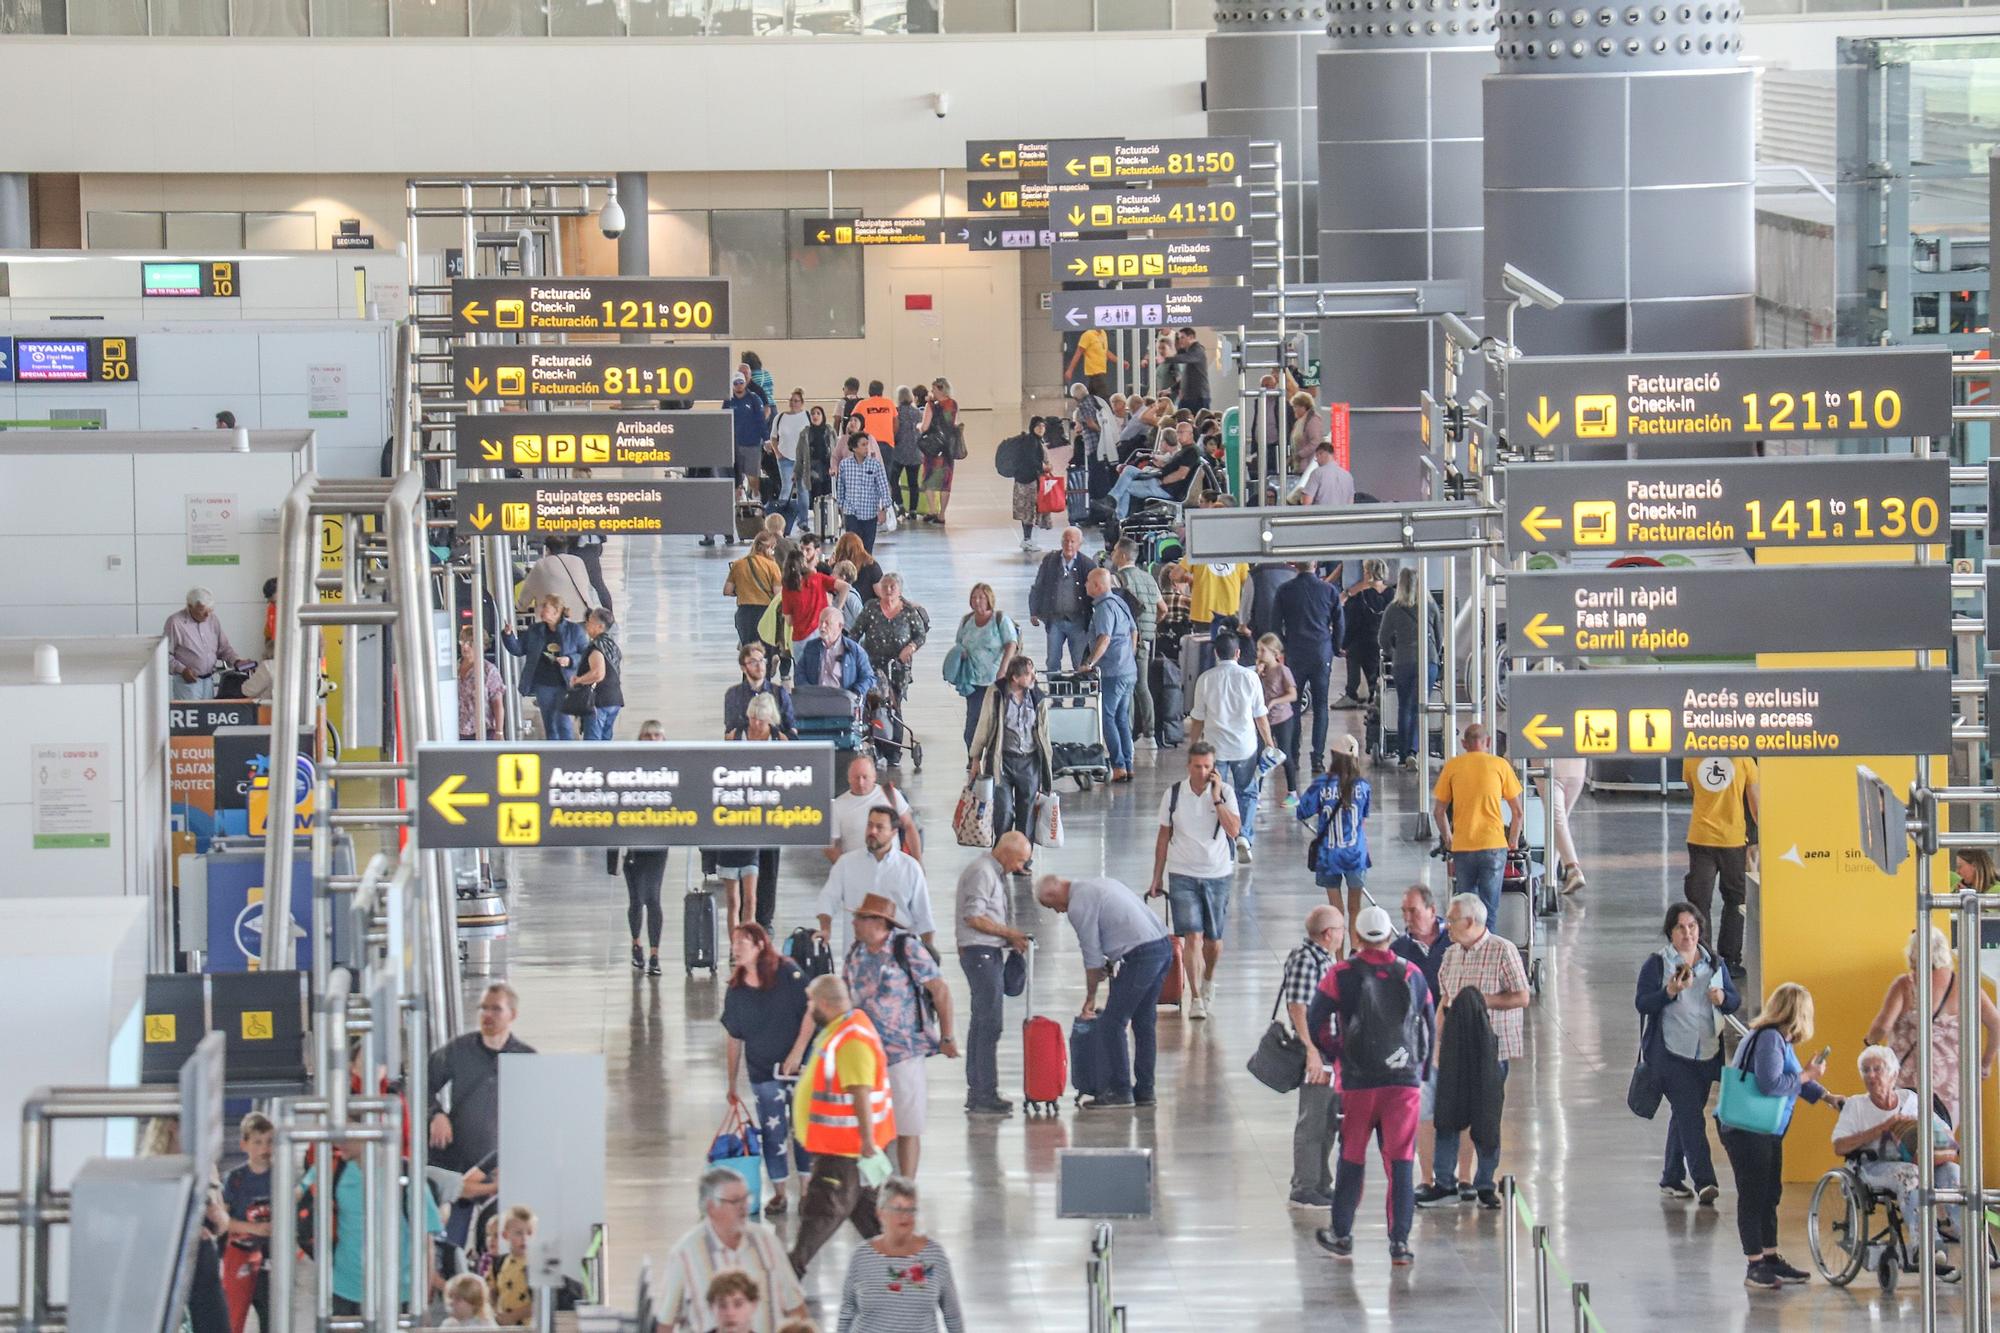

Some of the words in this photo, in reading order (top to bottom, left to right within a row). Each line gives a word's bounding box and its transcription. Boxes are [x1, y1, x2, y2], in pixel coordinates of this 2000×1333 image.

[1115, 145, 1159, 155] Facturació
[1116, 156, 1148, 164] Check-in
[1116, 166, 1165, 175] Facturación
[1168, 153, 1195, 173] 81
[1206, 152, 1234, 172] 50
[1117, 194, 1160, 204] Facturació
[1117, 205, 1149, 214] Check-in
[1117, 215, 1166, 224] Facturación
[1168, 203, 1196, 222] 41
[1208, 202, 1235, 221] 10
[855, 220, 893, 229] Equipatges
[894, 219, 925, 229] especials
[855, 234, 891, 243] Equipajes
[891, 234, 925, 243] especiales
[1168, 243, 1210, 255] Arribades
[1168, 254, 1196, 263] Arrivals
[1168, 262, 1208, 275] Llegadas
[213, 281, 233, 295] 10
[531, 288, 591, 300] Facturació
[1166, 294, 1202, 303] Lavabos
[531, 301, 575, 312] Check-in
[659, 304, 669, 314] to
[1166, 305, 1191, 313] Toilets
[531, 315, 598, 327] Facturación
[602, 301, 656, 327] 121
[673, 302, 712, 328] 90
[1167, 315, 1192, 323] Aseos
[660, 318, 668, 327] a
[28, 344, 85, 353] RYANAIR
[532, 354, 592, 366] Facturació
[102, 361, 129, 380] 50
[532, 369, 576, 379] Check-in
[643, 370, 653, 380] to
[532, 382, 599, 393] Facturación
[604, 367, 640, 393] 81
[657, 368, 693, 394] 10
[1628, 373, 1720, 393] Facturació
[644, 385, 652, 393] a
[1628, 395, 1695, 413] Check-in
[1825, 391, 1840, 407] to
[1628, 412, 1731, 434] Facturación
[1743, 392, 1821, 432] 121
[1848, 390, 1901, 429] 10
[616, 422, 674, 434] Arribades
[1828, 415, 1837, 428] a
[616, 436, 655, 447] Arrivals
[617, 449, 670, 463] Llegadas
[1628, 479, 1722, 499] Facturació
[537, 490, 603, 505] Equipatges
[606, 490, 661, 503] especials
[537, 503, 573, 517] Special
[576, 503, 619, 515] check-in
[1628, 502, 1696, 520] Check-in
[1830, 498, 1846, 515] to
[537, 516, 596, 531] Equipajes
[599, 517, 661, 531] especiales
[1628, 519, 1733, 541] Facturación
[1746, 499, 1826, 540] 141
[1854, 497, 1938, 537] 130
[1833, 523, 1843, 537] a
[1575, 588, 1624, 607] Carril
[1631, 587, 1677, 610] ràpid
[1577, 610, 1609, 628] Fast
[1614, 610, 1646, 627] lane
[1576, 630, 1624, 649] Carril
[1632, 629, 1689, 651] rápido
[1684, 688, 1738, 708] Accés
[1745, 688, 1818, 707] exclusiu
[207, 712, 239, 725] BAG
[1683, 710, 1755, 728] Exclusive
[1760, 713, 1813, 727] access
[1685, 731, 1749, 750] Acceso
[1756, 731, 1838, 749] exclusivo
[550, 767, 602, 787] Accés
[607, 767, 679, 787] exclusiu
[713, 767, 762, 786] Carril
[766, 766, 812, 789] ràpid
[549, 789, 617, 806] Exclusive
[621, 791, 672, 805] access
[713, 785, 744, 804] Fast
[747, 788, 780, 804] lane
[550, 808, 613, 826] Acceso
[617, 807, 697, 826] exclusivo
[713, 807, 762, 825] Carril
[766, 806, 822, 828] rápido
[1804, 850, 1831, 859] aena
[1845, 848, 1861, 858] sin
